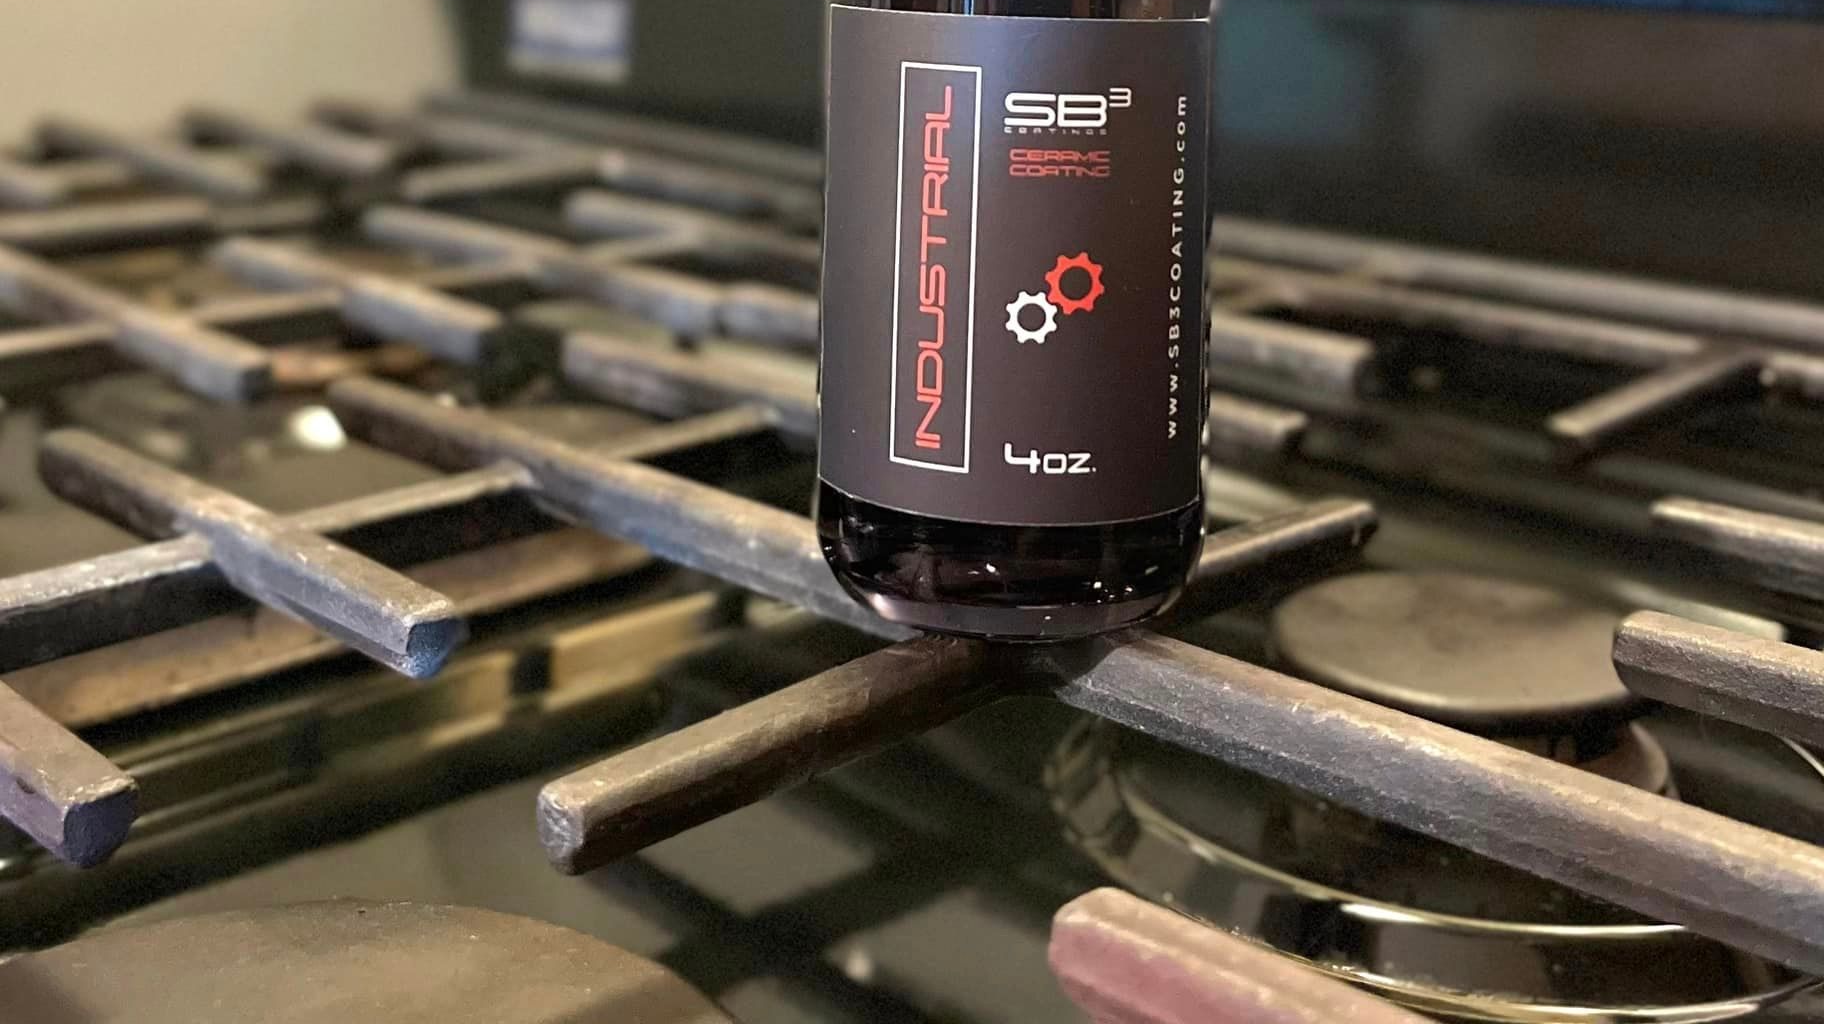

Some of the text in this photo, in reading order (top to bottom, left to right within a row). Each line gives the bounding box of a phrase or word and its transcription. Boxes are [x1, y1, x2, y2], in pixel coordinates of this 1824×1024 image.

[1004, 126, 1107, 135] COATINGS
[1009, 149, 1110, 162] CERAMIC
[1009, 164, 1110, 176] COATING
[915, 85, 953, 449] INDUSTRIAL
[1168, 96, 1187, 439] www.SB3COATING.com
